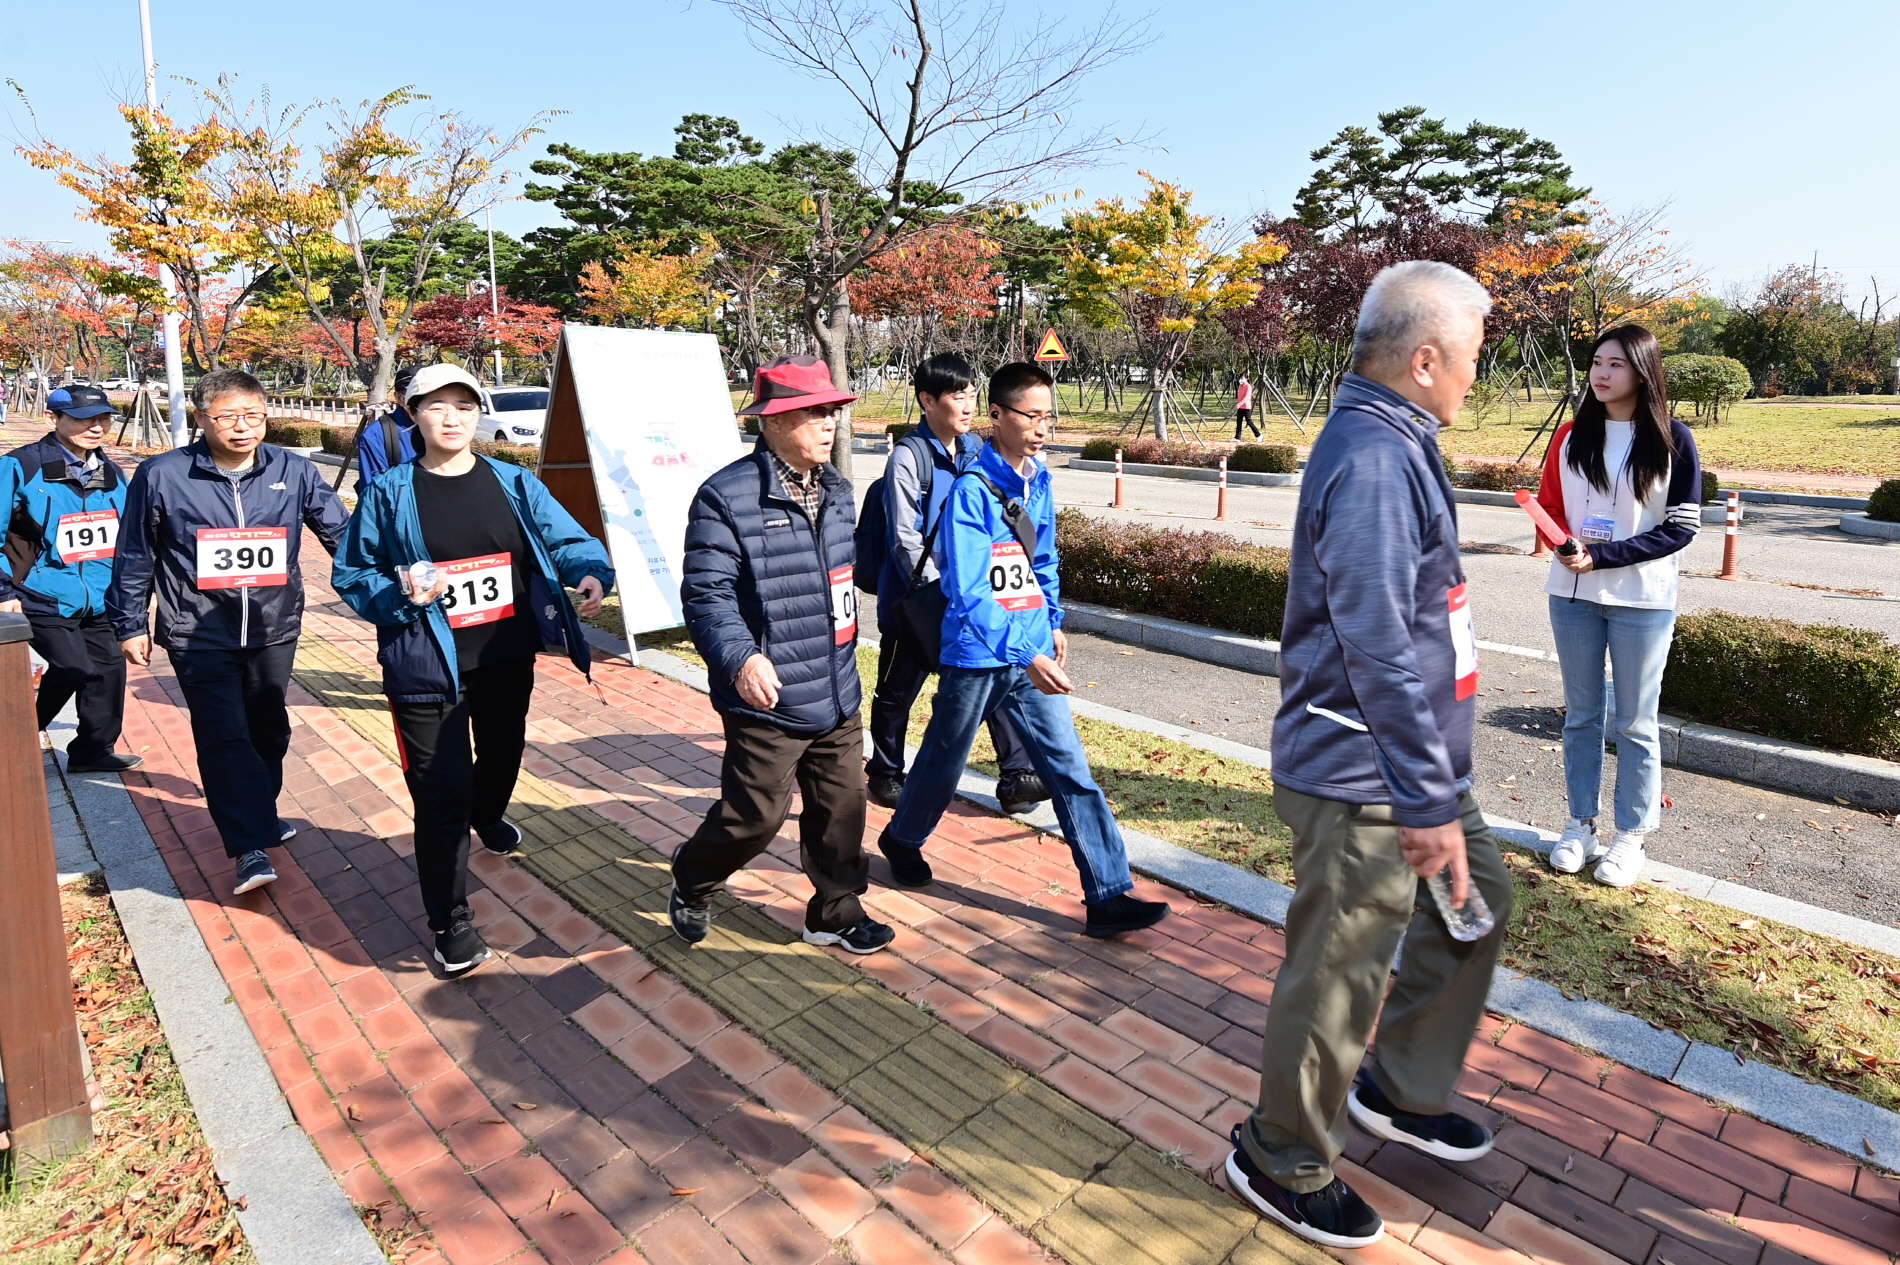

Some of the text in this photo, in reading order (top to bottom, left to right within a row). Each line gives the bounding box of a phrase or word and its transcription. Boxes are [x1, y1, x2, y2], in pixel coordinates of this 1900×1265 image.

[64, 525, 109, 549] 191
[1584, 529, 1609, 538] 진행요원
[213, 546, 275, 571] 390
[444, 576, 499, 610] 313
[843, 591, 852, 619] 0
